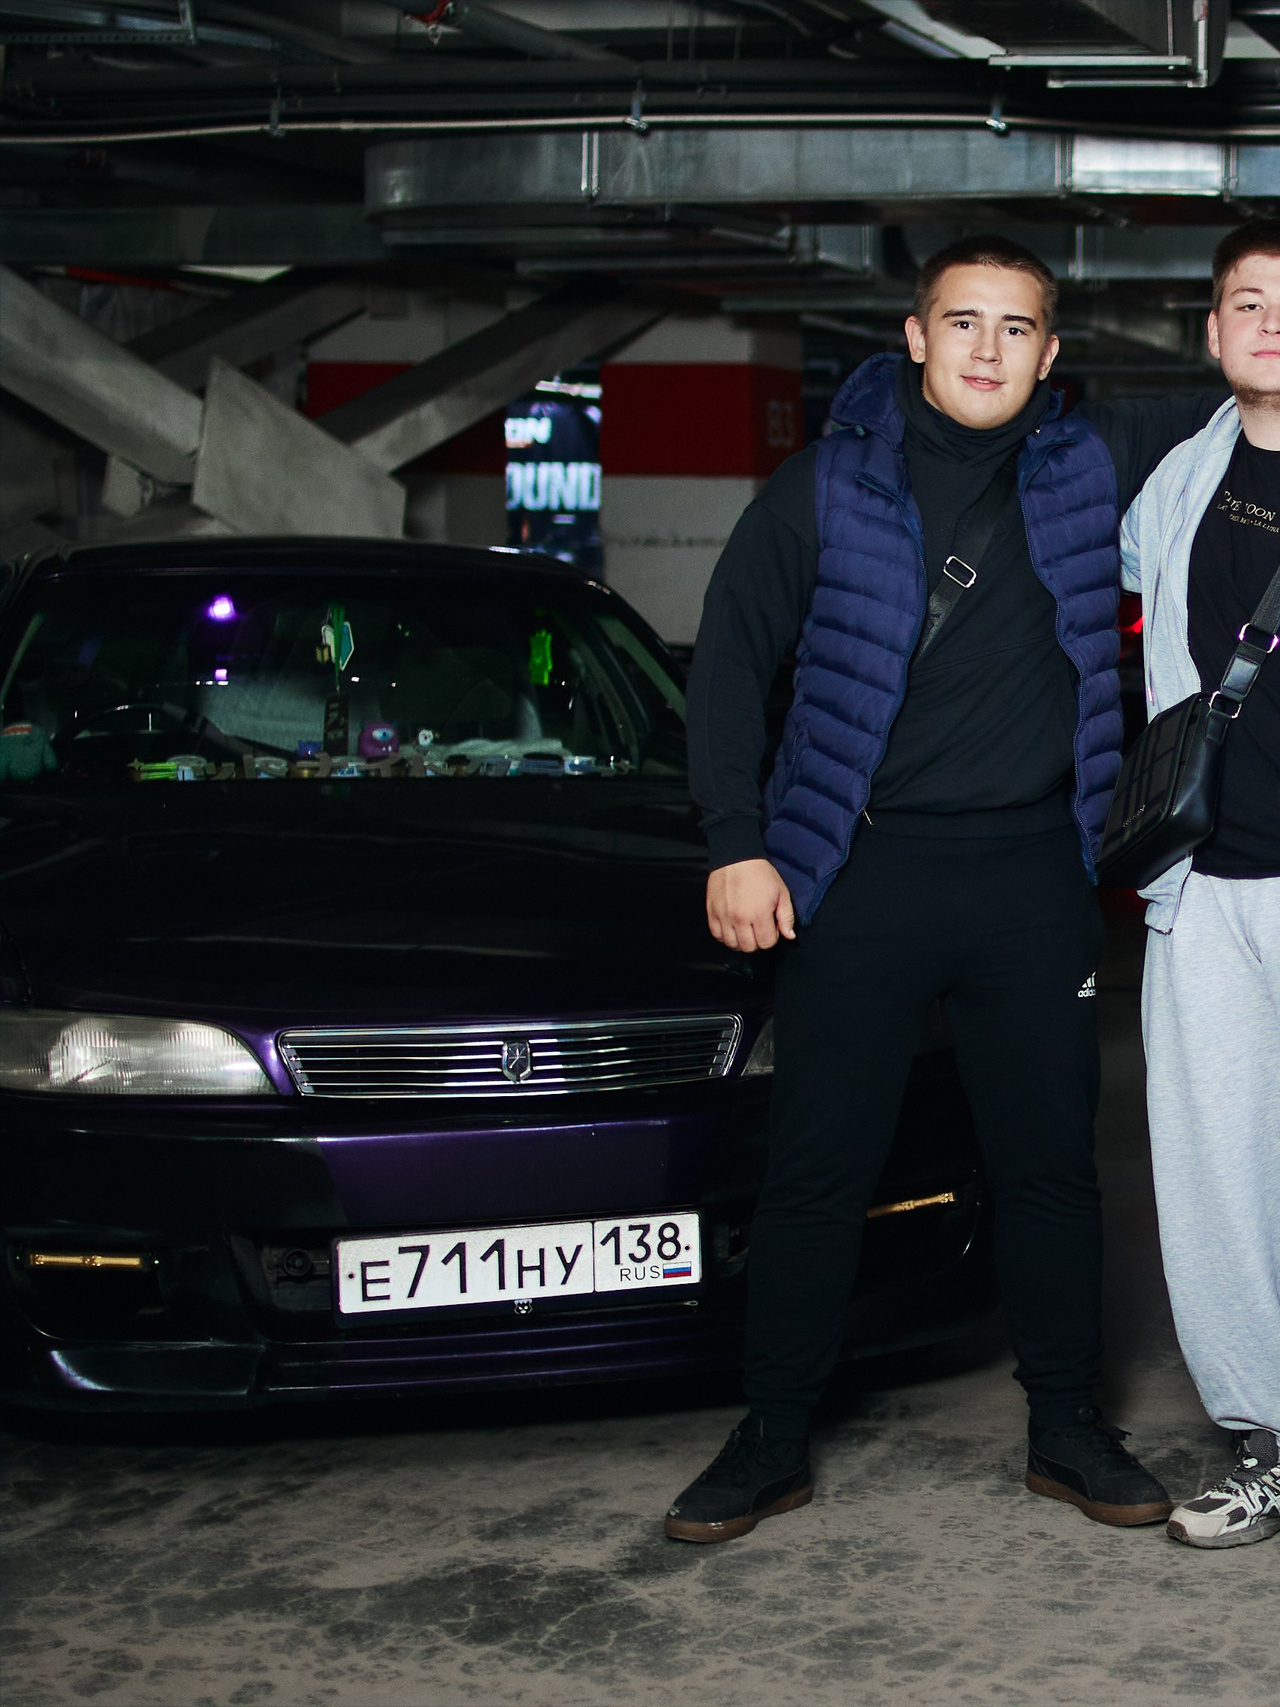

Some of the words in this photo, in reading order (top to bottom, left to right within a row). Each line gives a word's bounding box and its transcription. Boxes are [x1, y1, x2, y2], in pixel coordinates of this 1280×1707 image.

[361, 1238, 583, 1302] Е711НУ
[600, 1222, 682, 1265] 138
[619, 1265, 660, 1282] RUS
